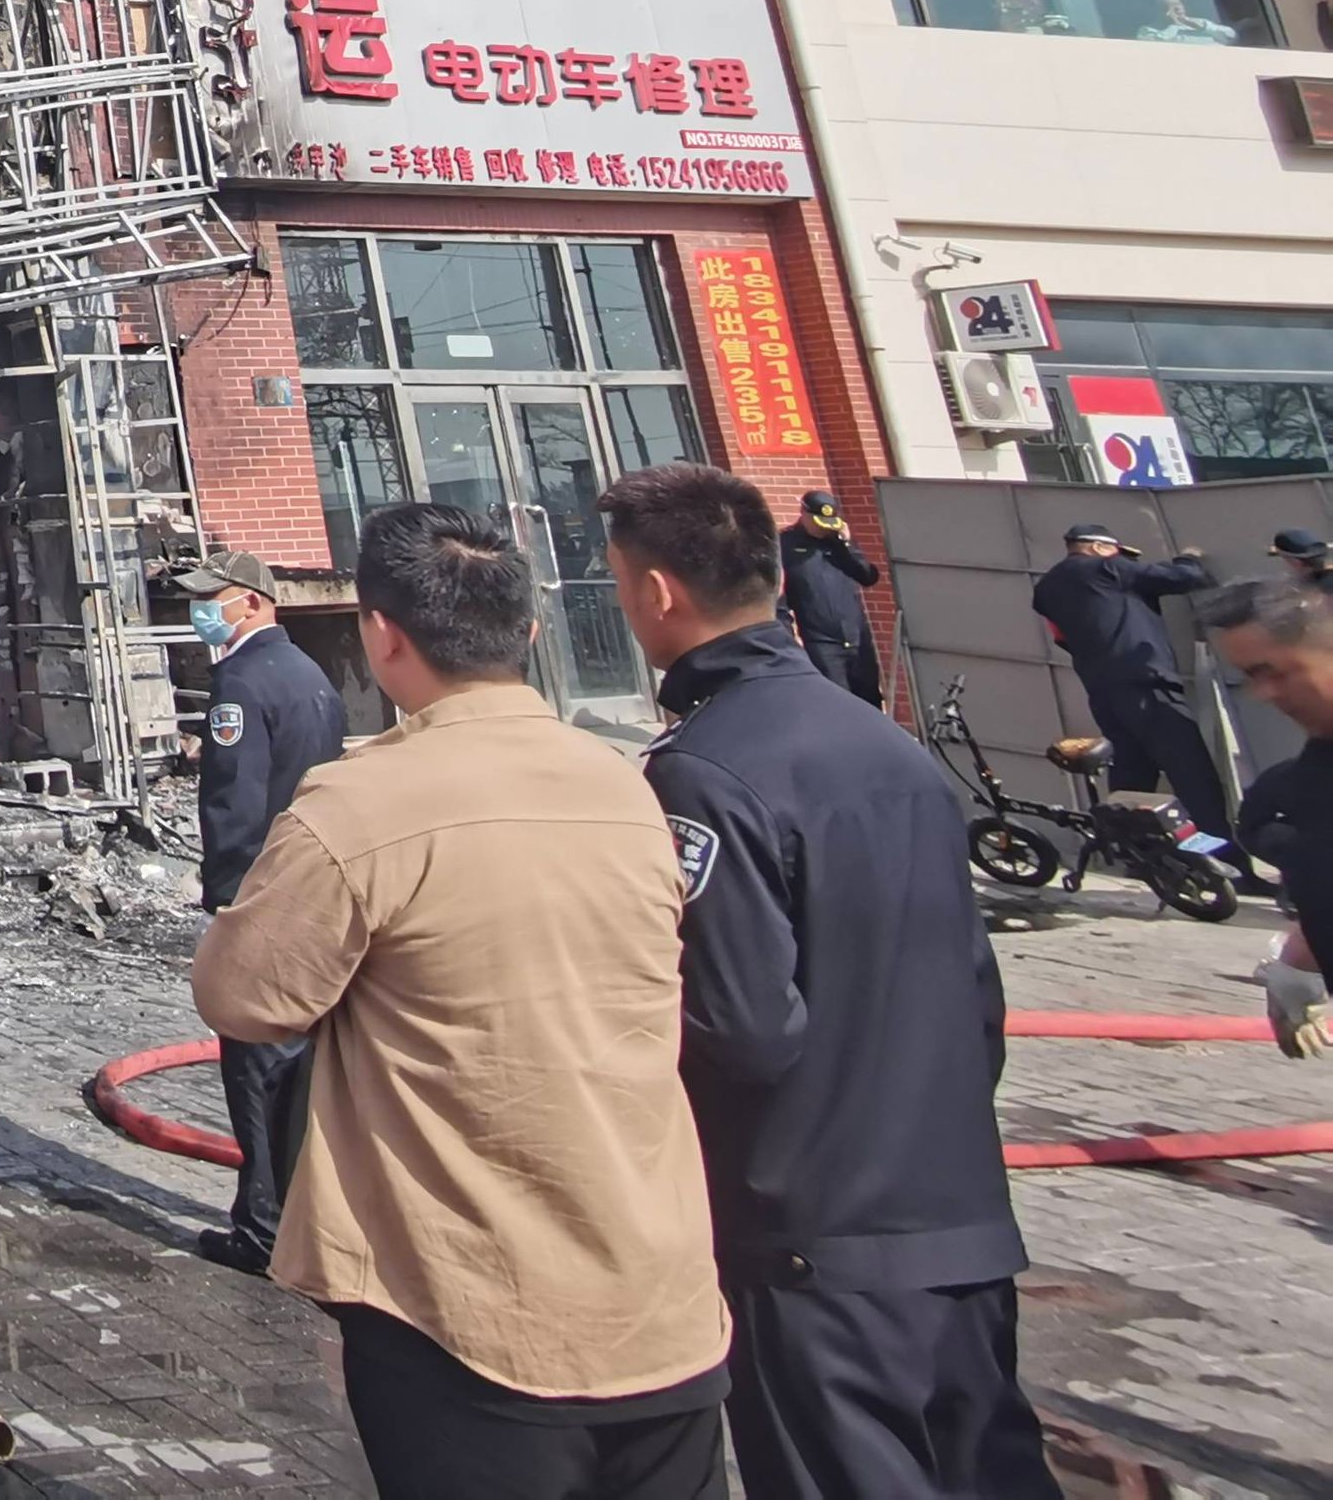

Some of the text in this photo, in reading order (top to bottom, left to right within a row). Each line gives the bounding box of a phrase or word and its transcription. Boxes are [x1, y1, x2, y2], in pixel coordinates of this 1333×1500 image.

[422, 39, 758, 119] 电动车修理
[369, 144, 474, 182] 二手车销售
[483, 147, 529, 182] 回收
[536, 149, 579, 184] 修理
[741, 256, 812, 445] 18341911118
